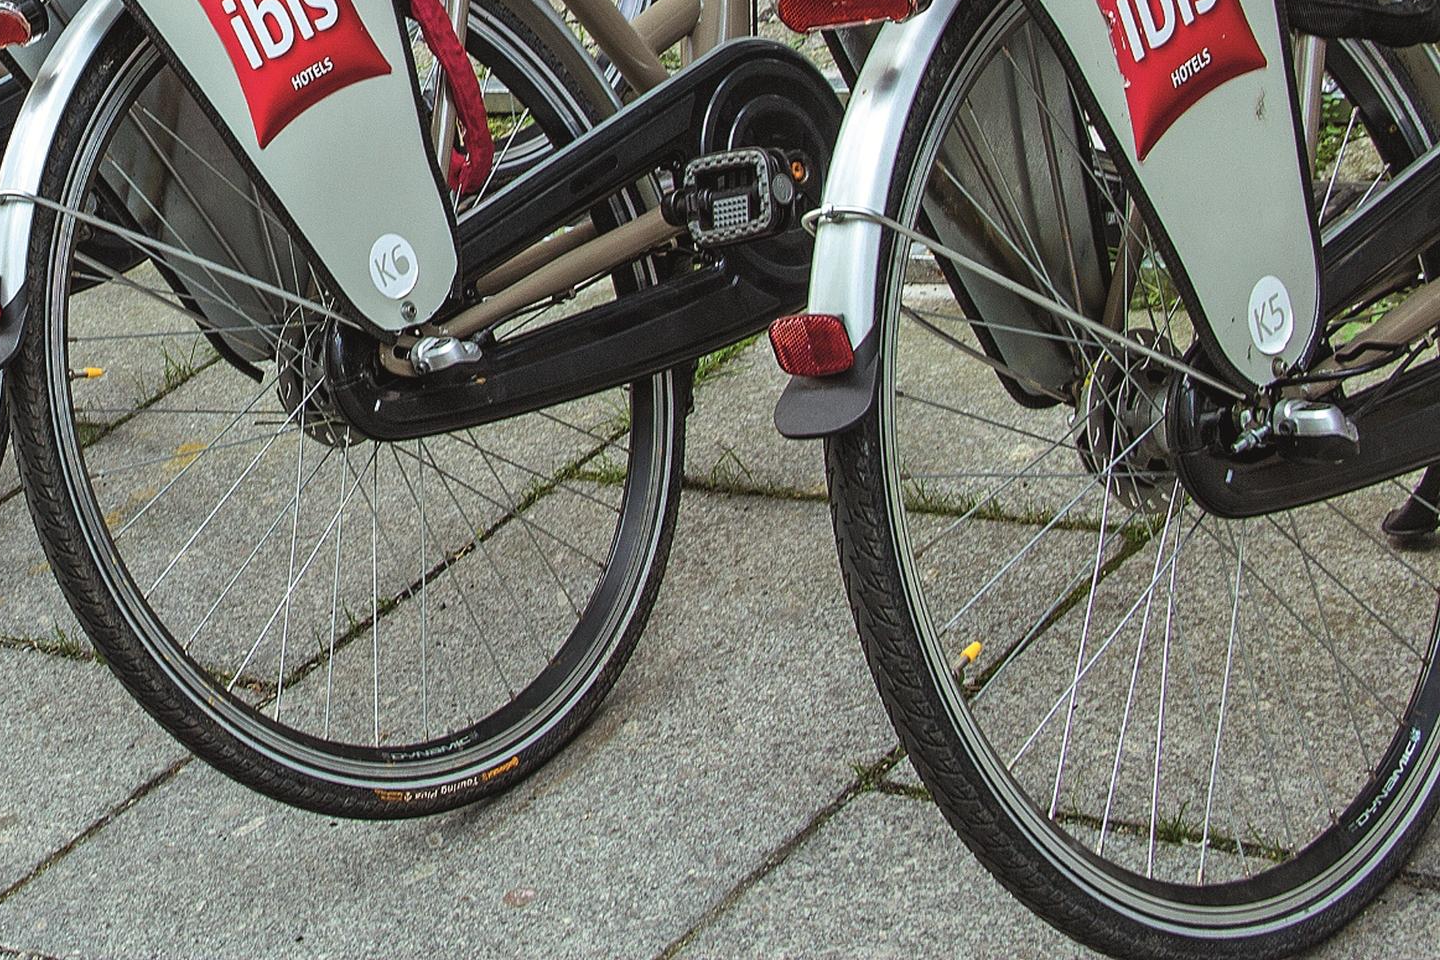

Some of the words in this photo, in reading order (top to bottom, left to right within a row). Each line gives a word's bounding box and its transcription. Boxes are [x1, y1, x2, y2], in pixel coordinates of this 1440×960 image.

[291, 56, 334, 90] HOTELS
[1170, 47, 1211, 89] HOTELS
[374, 244, 410, 287] K6
[1253, 292, 1285, 344] K5
[440, 776, 479, 796] Touring
